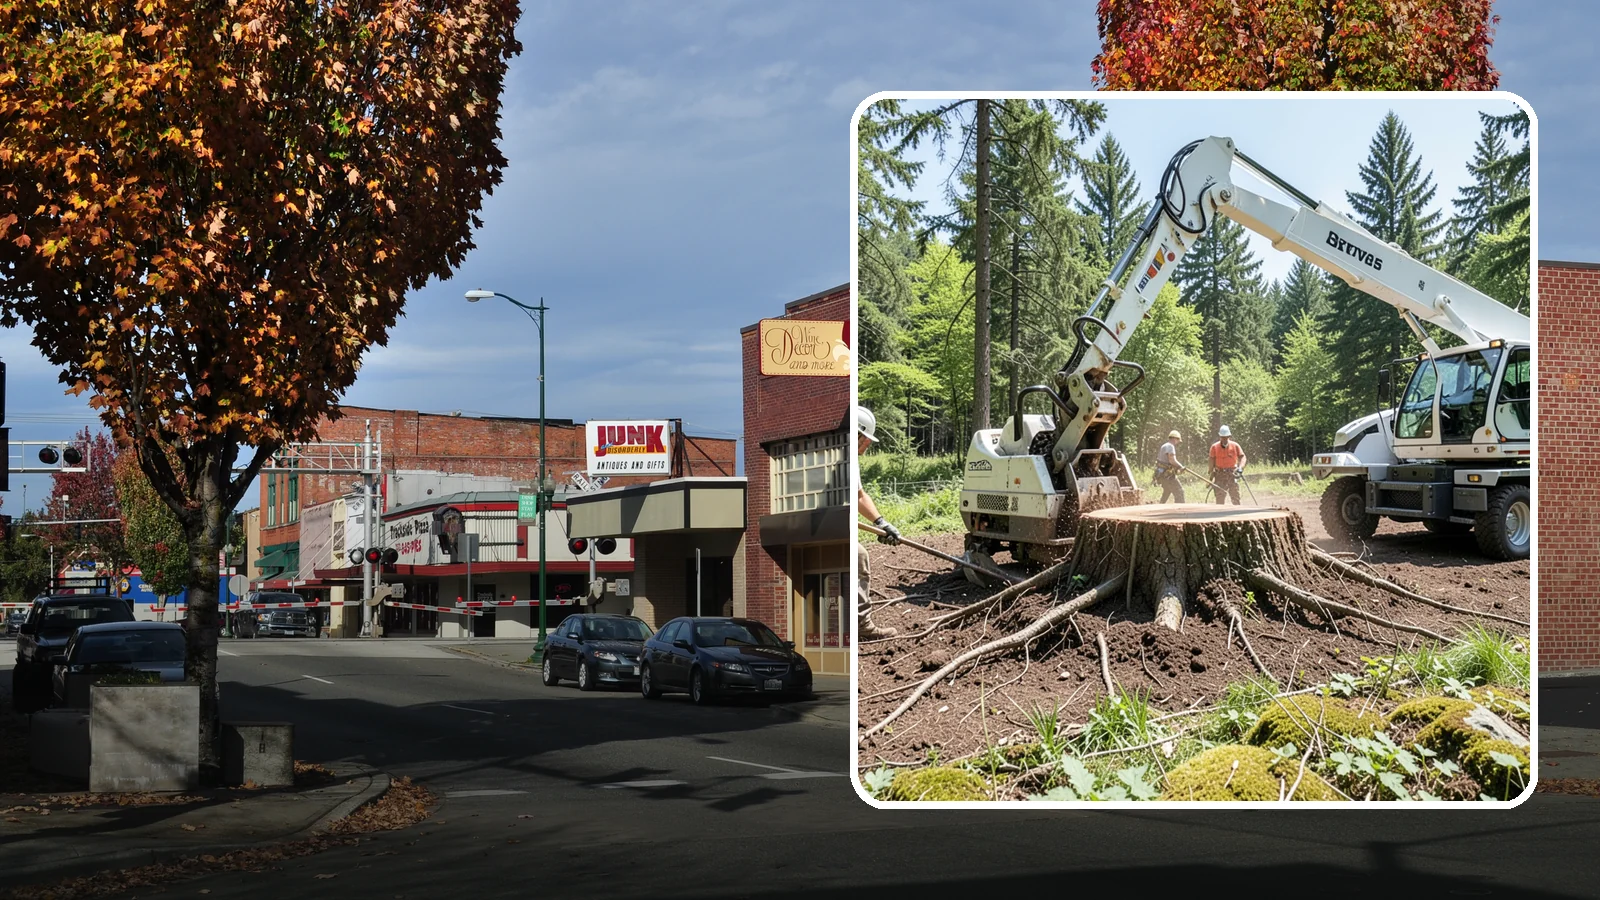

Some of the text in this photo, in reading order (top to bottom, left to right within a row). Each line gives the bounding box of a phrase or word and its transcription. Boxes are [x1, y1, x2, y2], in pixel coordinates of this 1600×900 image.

[595, 425, 665, 457] JUNK
[597, 460, 665, 470] ANTIQUES AND GIFTS
[414, 519, 429, 535] Pizza
